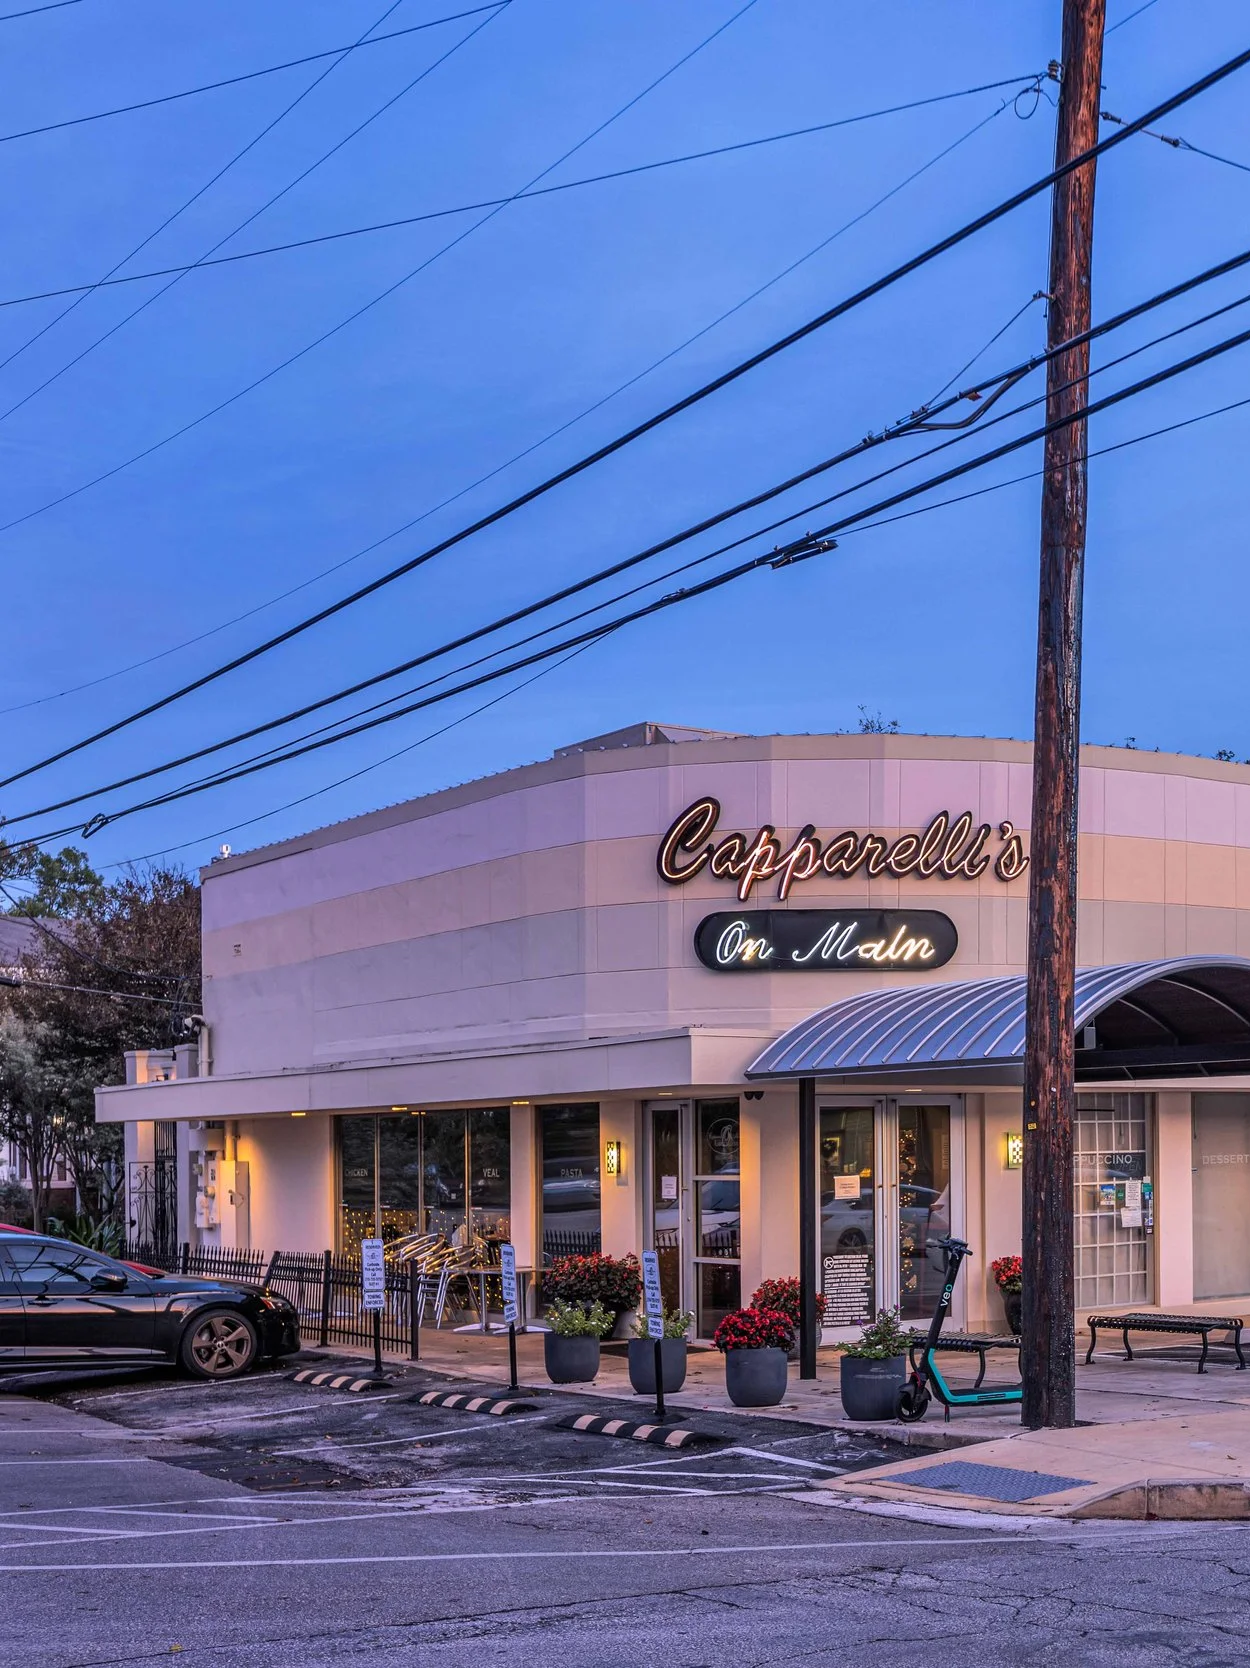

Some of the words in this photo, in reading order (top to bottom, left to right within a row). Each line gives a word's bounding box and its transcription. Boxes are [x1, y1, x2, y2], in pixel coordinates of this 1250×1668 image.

[656, 796, 1030, 902] Capparelli's
[715, 920, 773, 963] On
[1073, 1154, 1133, 1165] PPUCCINO
[1202, 1154, 1250, 1165] DESSERT
[482, 1167, 500, 1178] VEAL
[560, 1168, 584, 1179] PASTA
[940, 1283, 953, 1307] veo
